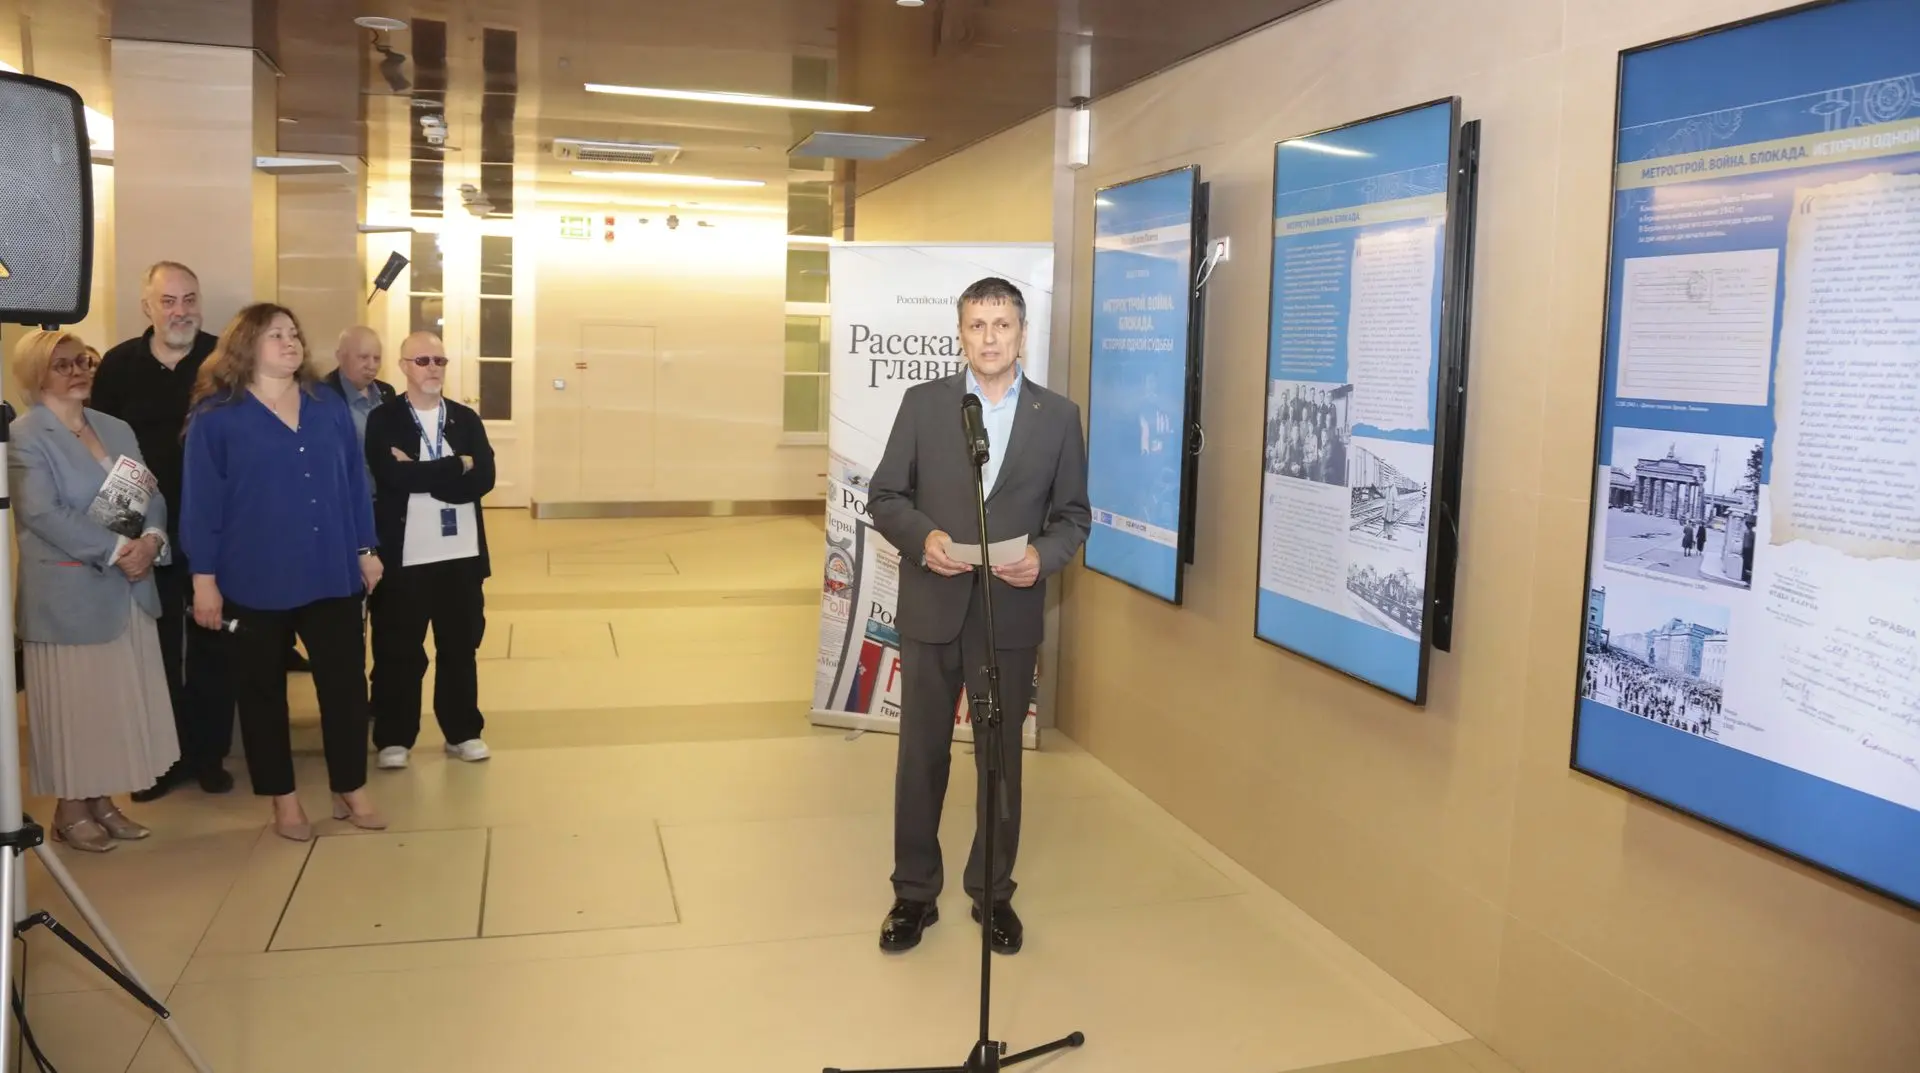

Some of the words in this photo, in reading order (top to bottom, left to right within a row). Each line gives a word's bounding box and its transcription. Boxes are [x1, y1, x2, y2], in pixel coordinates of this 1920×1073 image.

[1641, 158, 1707, 180] МЕТРОСТРОЙ.
[1709, 153, 1746, 171] ВОЙНА.
[1750, 145, 1809, 166] БЛОКАДА.
[896, 295, 948, 305] Российская
